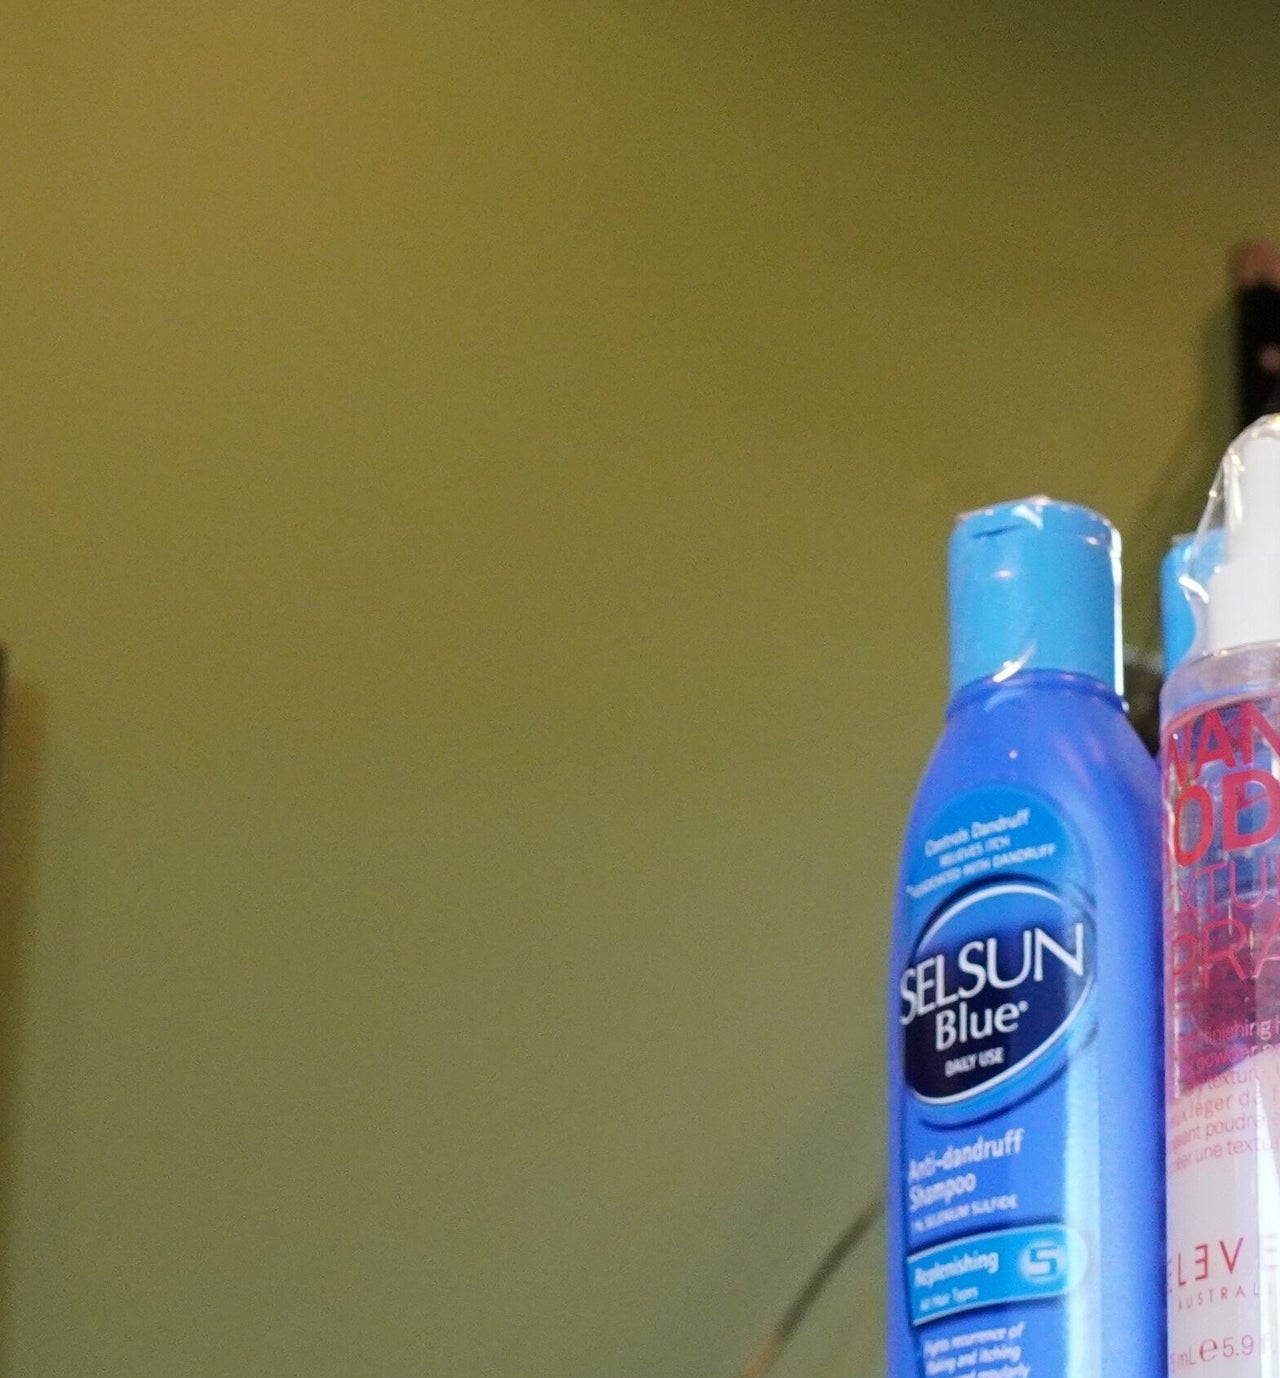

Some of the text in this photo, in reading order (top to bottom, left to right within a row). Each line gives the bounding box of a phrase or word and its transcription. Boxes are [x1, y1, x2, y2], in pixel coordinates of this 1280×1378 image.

[899, 922, 1084, 1026] SELSUN
[945, 1047, 1004, 1077] DAILY USE
[909, 1128, 1025, 1182] Anti-dandruff
[909, 1173, 977, 1212] Shampoo
[914, 1252, 999, 1288] Replenishing
